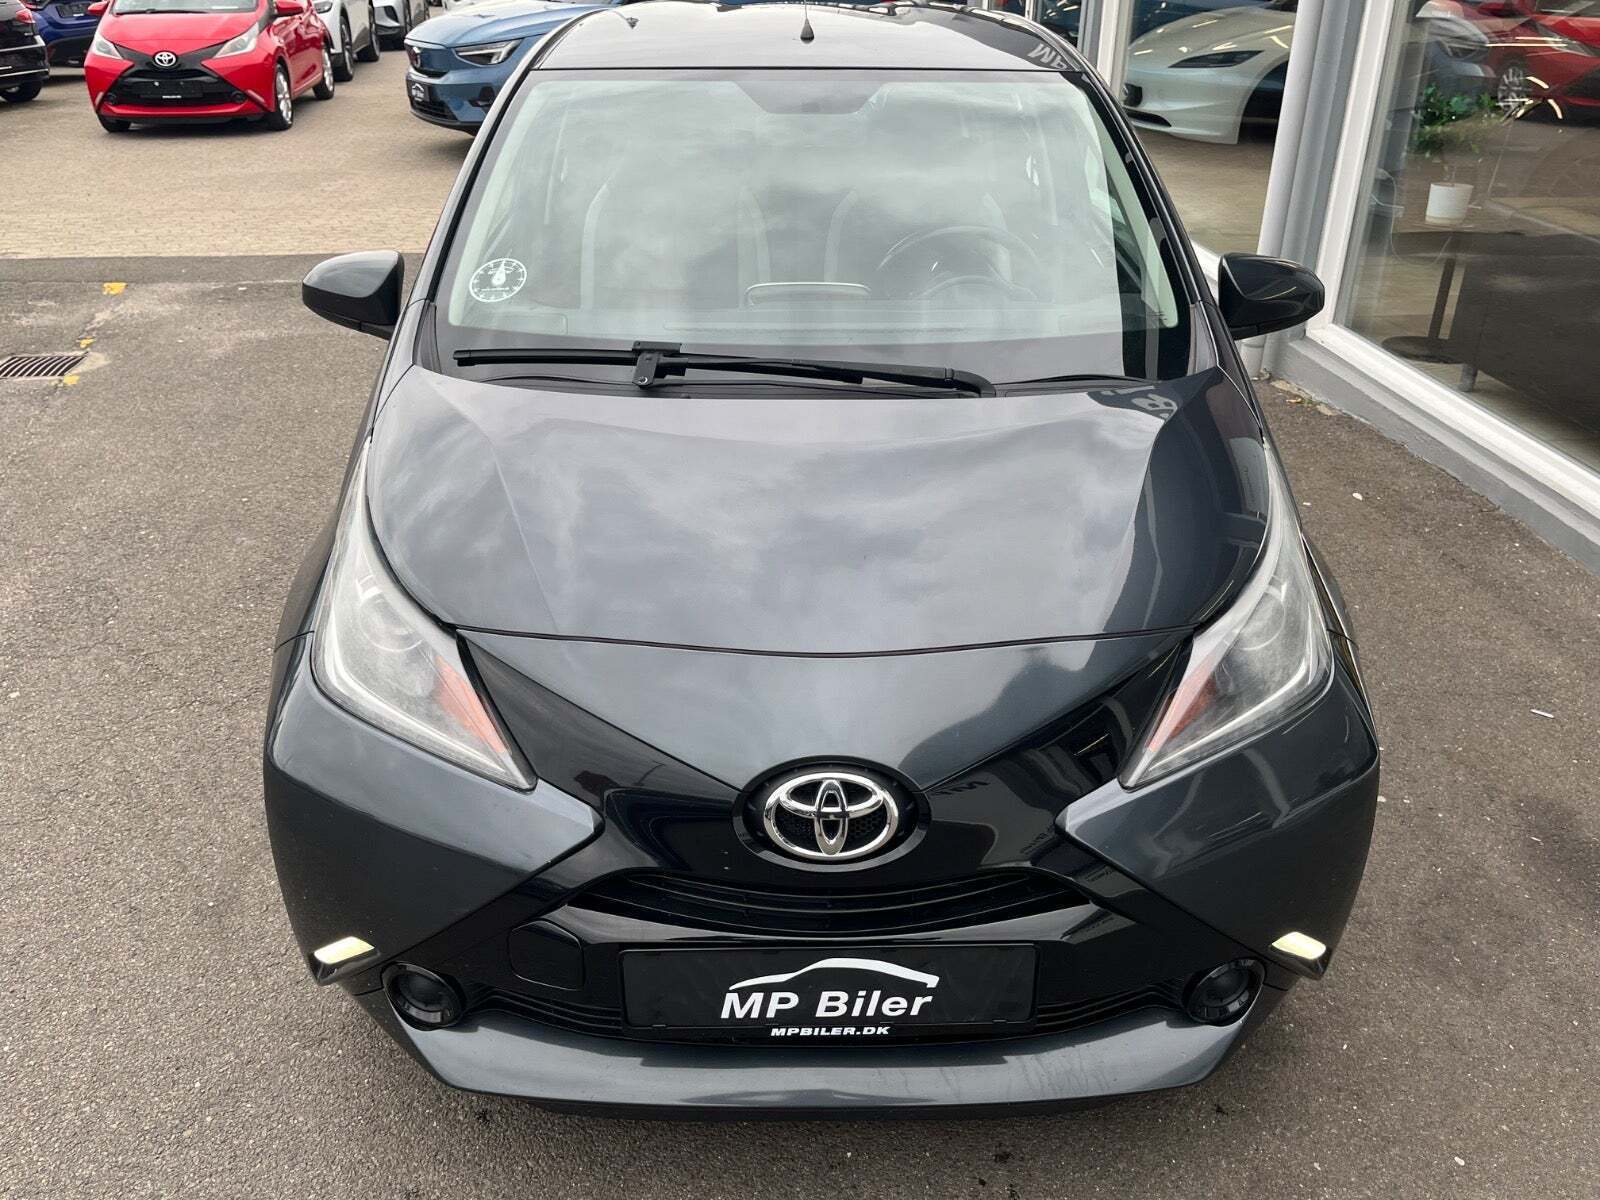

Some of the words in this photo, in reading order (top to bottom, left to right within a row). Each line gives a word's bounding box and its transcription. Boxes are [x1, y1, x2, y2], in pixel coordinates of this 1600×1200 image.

[720, 991, 800, 1019] MP
[815, 990, 933, 1018] Biler
[770, 1026, 891, 1037] MPBILER.DK
